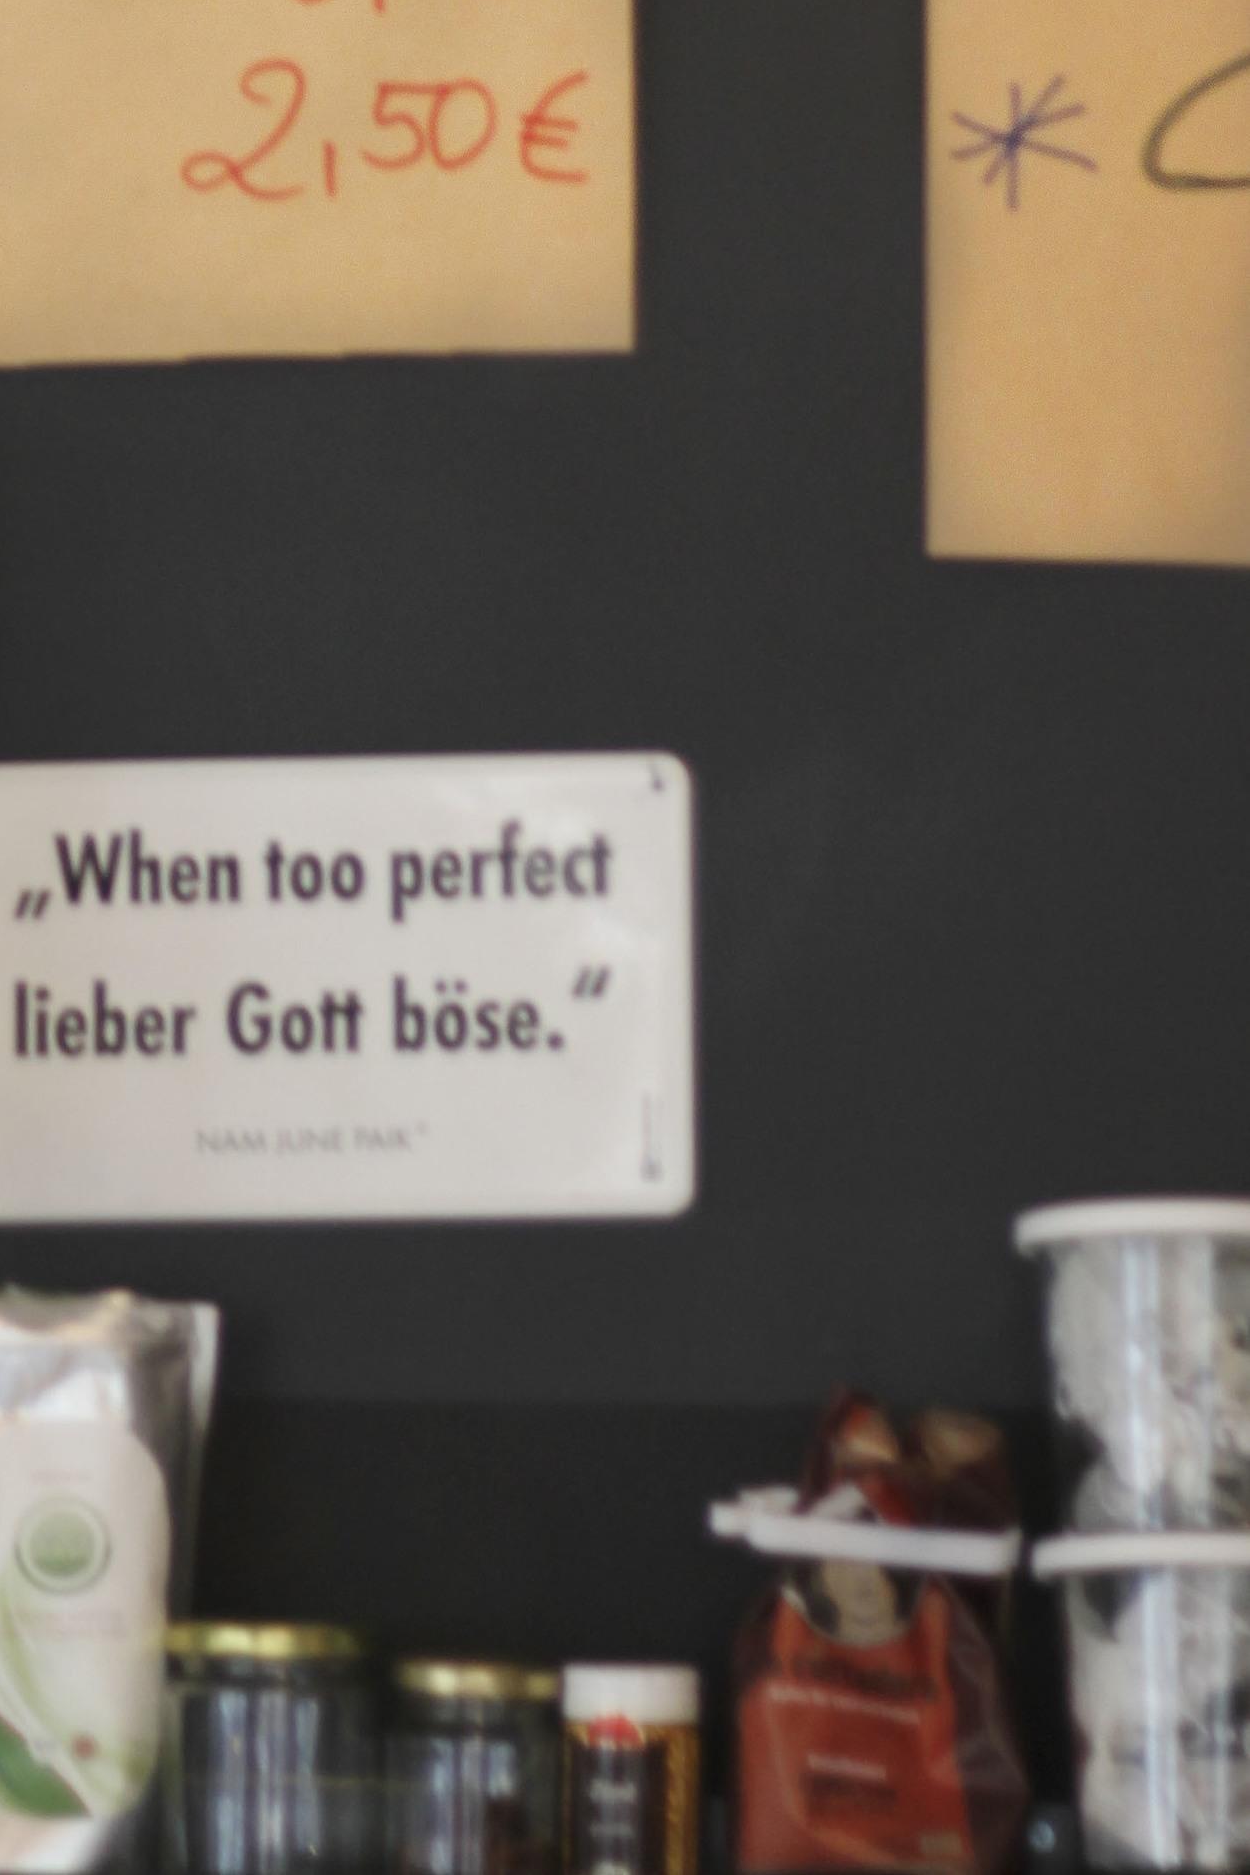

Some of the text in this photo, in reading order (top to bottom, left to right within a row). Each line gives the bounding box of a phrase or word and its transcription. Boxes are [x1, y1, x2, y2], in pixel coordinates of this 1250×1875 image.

[263, 840, 366, 903] too
[390, 820, 612, 922] perfect
[13, 980, 196, 1057] lieber
[225, 982, 363, 1055] Gott
